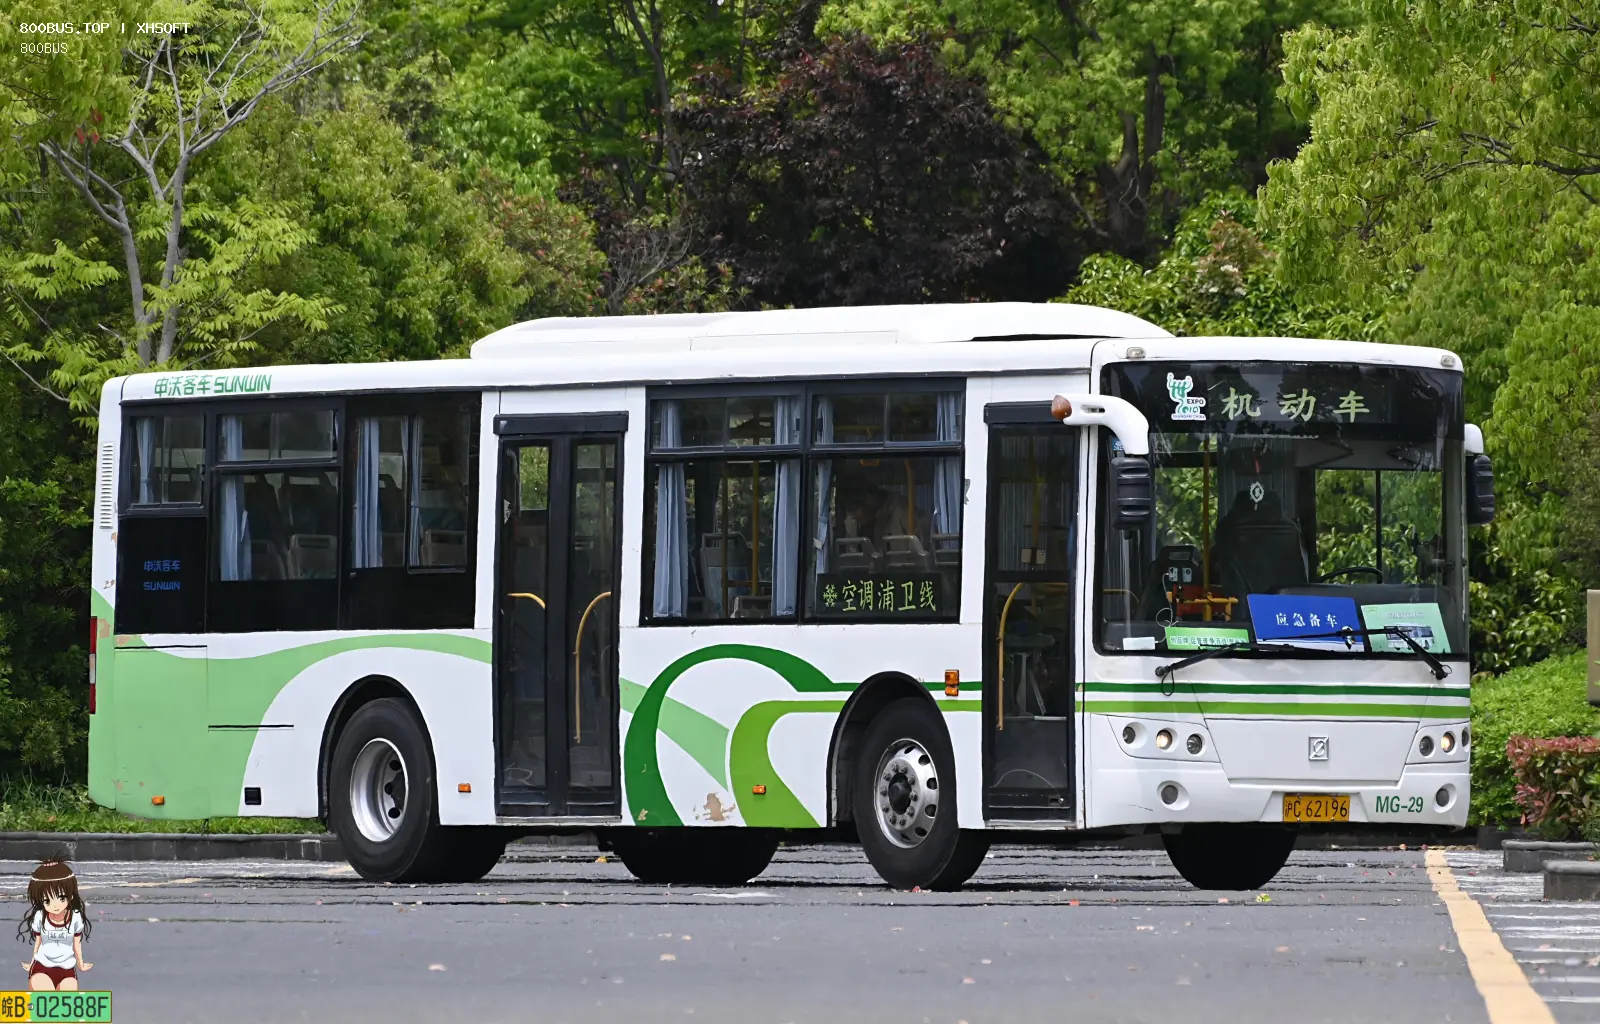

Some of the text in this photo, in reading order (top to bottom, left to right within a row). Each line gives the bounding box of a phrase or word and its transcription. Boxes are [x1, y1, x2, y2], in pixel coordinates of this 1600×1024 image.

[154, 374, 272, 397] 申沃客车 SUNWIN
[1221, 387, 1370, 423] 机动车
[143, 560, 180, 572] 申沃客车
[143, 581, 181, 590] SUNWIN
[842, 580, 937, 612] 空调浦卫线
[1275, 612, 1338, 628] 应急备车
[1375, 795, 1424, 813] MG-29
